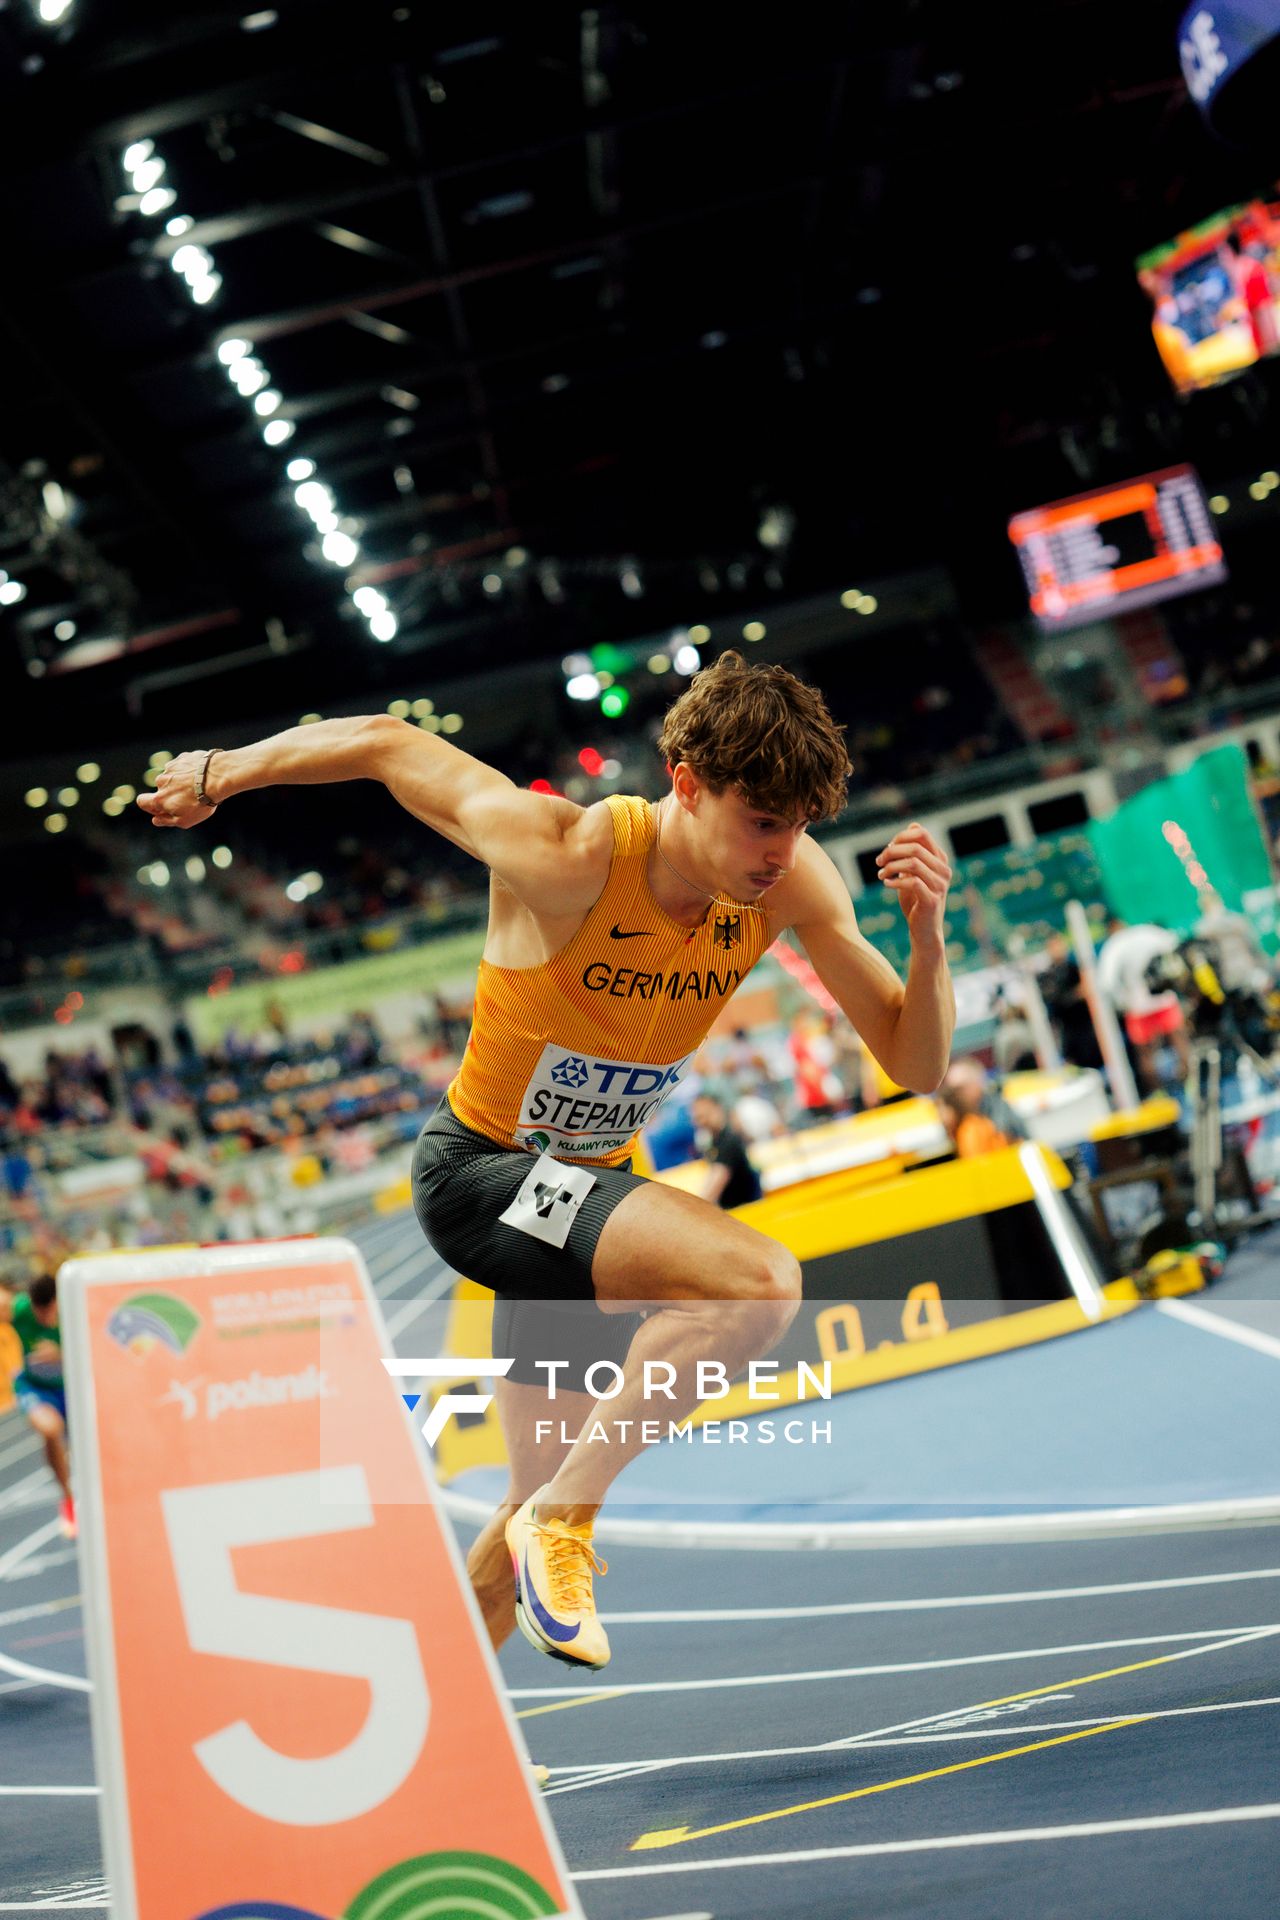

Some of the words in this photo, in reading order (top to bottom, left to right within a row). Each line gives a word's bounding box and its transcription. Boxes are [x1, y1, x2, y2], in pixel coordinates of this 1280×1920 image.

[582, 962, 750, 1001] GERMANY
[593, 1057, 688, 1096] TDK
[557, 1140, 602, 1152] KUJAWY
[206, 1364, 329, 1421] polanik
[159, 1462, 432, 1827] 5
